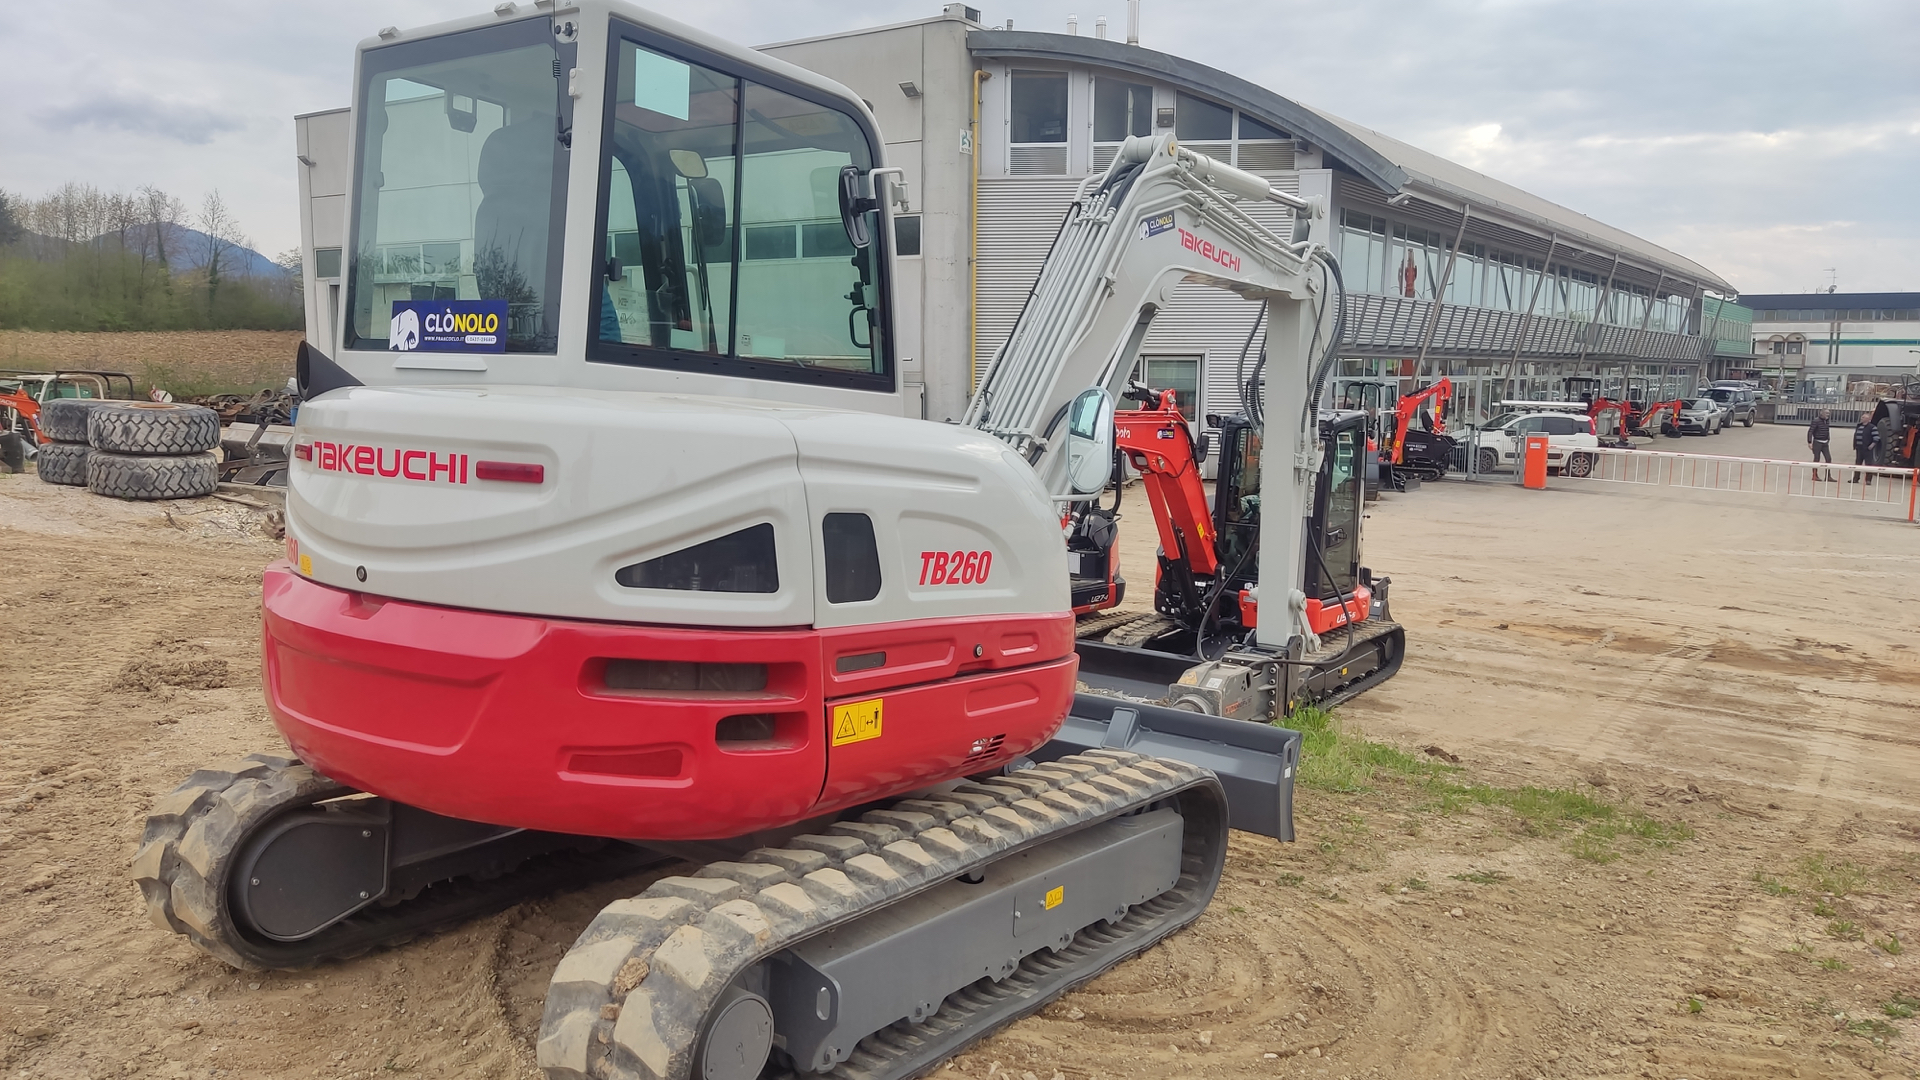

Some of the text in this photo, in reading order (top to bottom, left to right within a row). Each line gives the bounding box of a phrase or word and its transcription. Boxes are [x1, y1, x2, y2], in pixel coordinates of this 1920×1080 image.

[1178, 228, 1241, 273] TAKEUCHI
[425, 308, 499, 333] CLÒNOLO
[314, 441, 468, 485] TAKEUCHI
[918, 550, 993, 586] TB260
